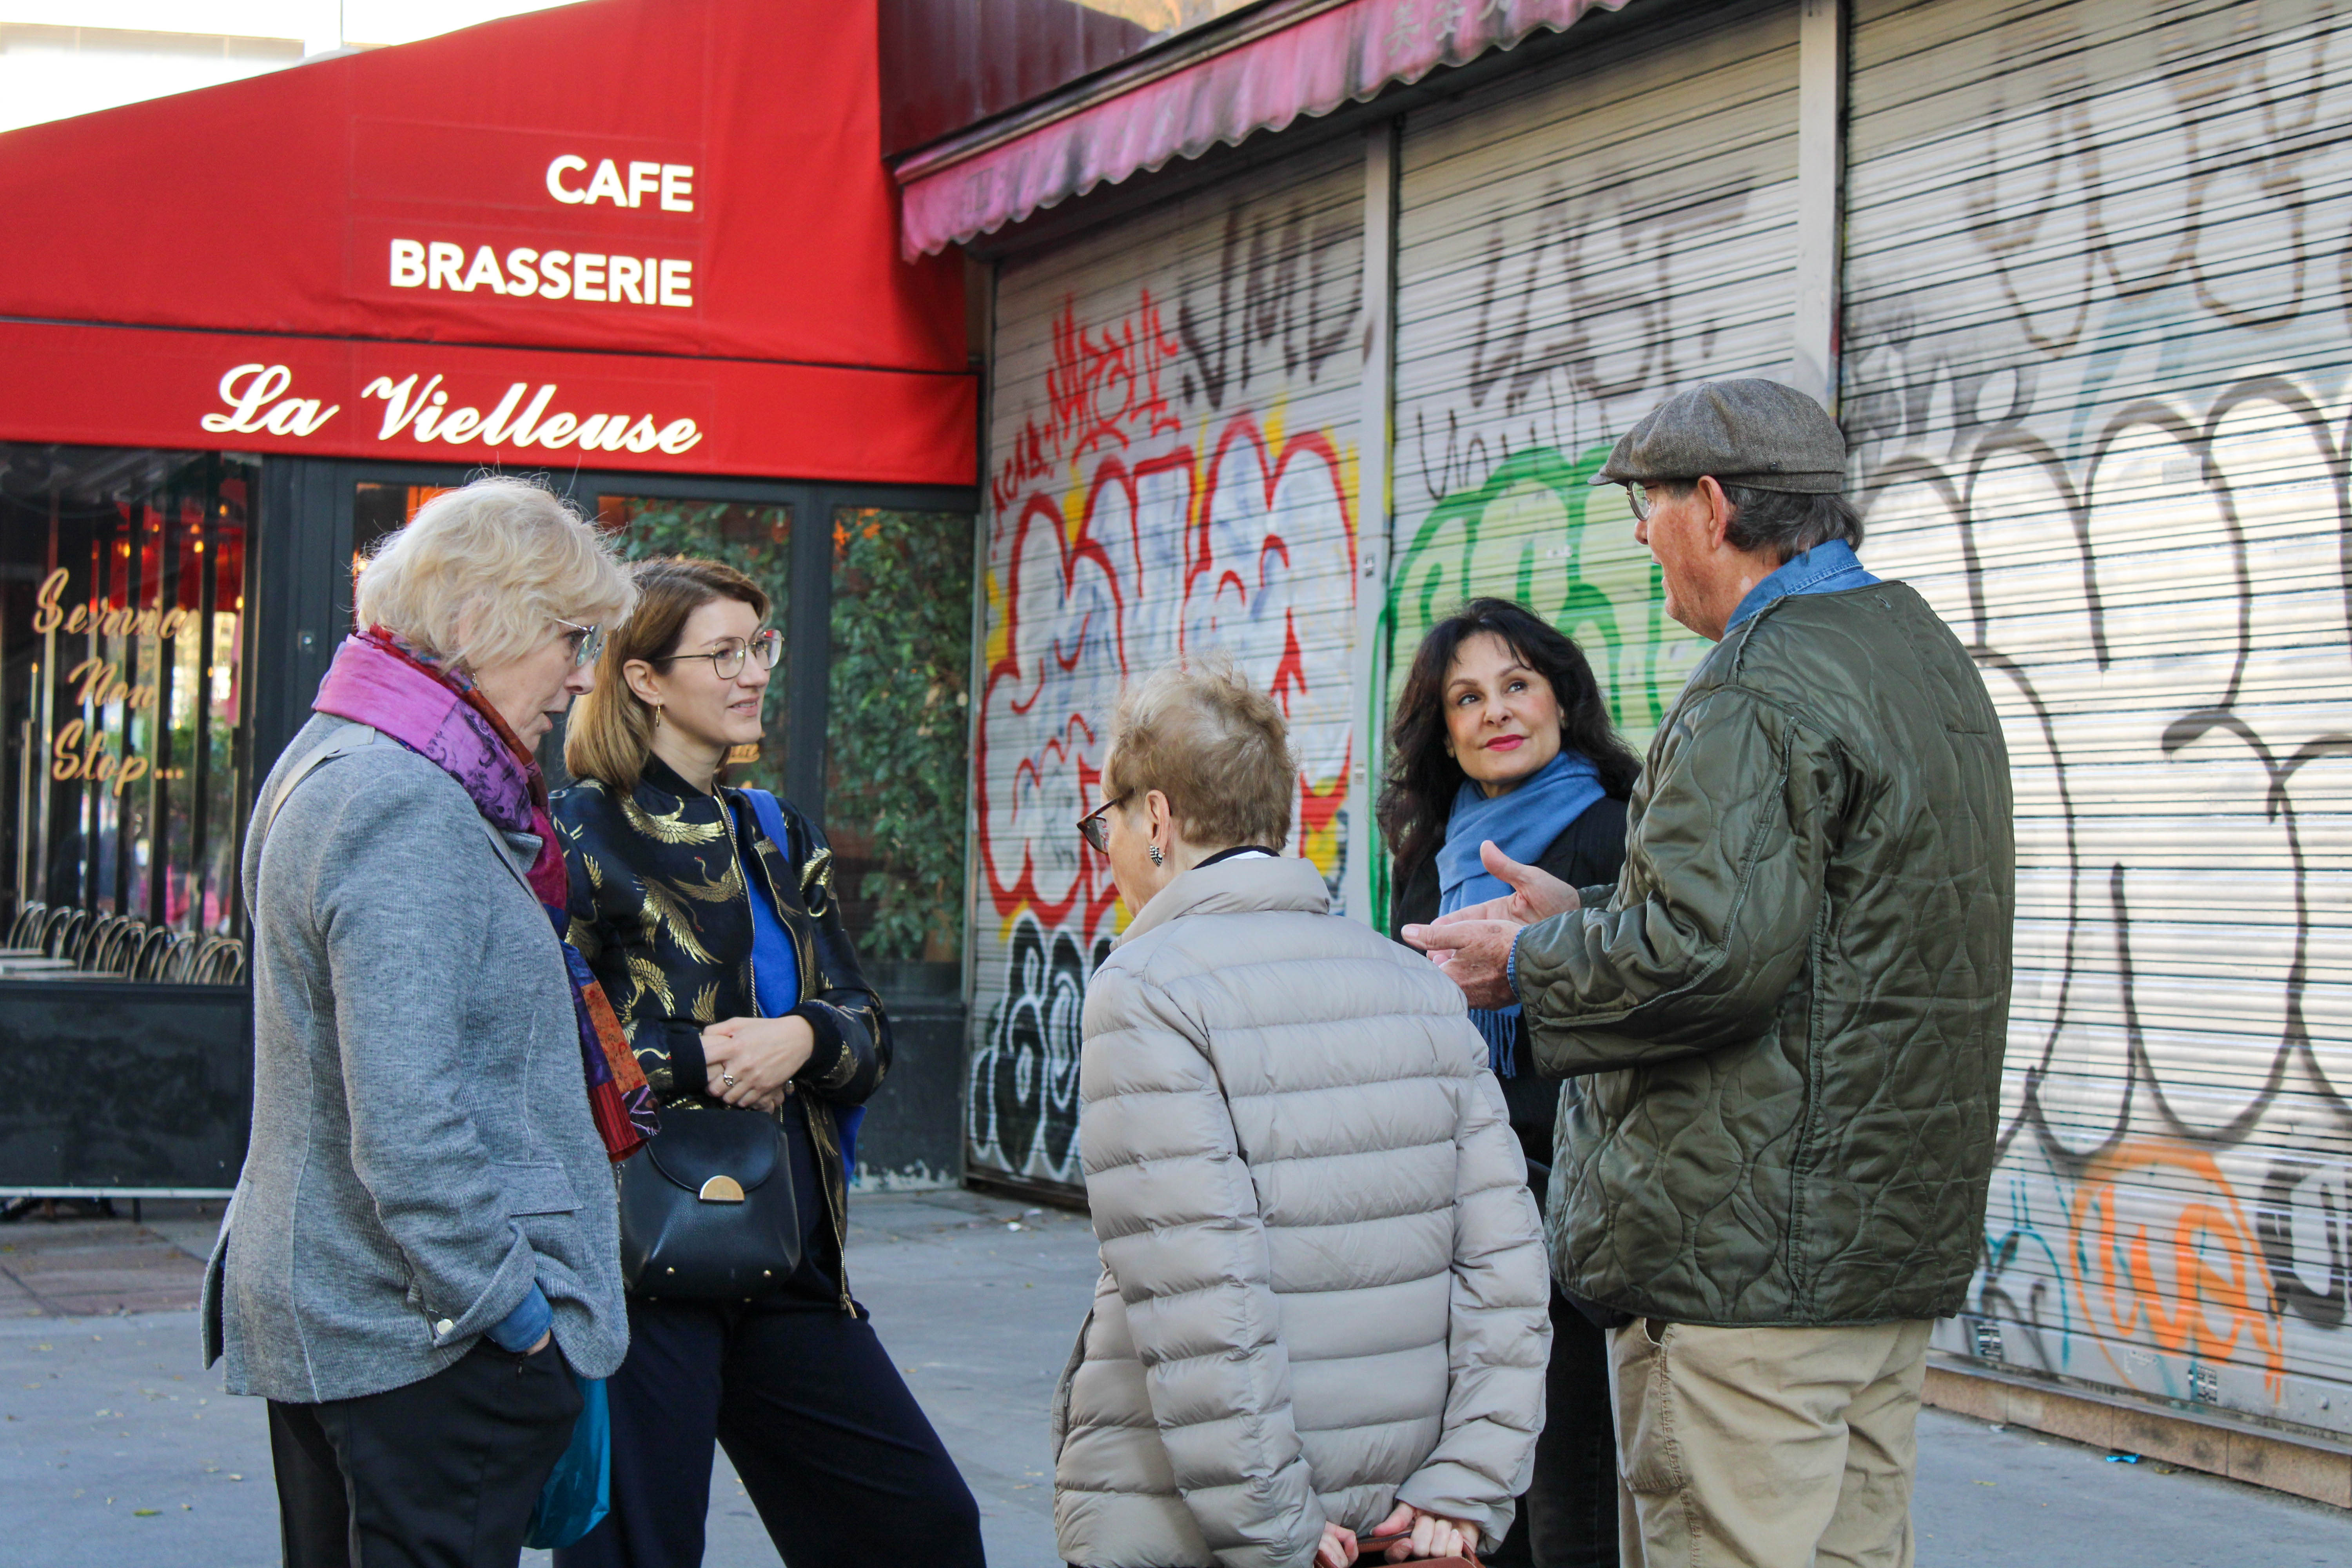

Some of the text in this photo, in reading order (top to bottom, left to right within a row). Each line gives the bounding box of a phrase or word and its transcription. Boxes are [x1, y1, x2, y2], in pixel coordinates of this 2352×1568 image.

[546, 154, 694, 212] CAFE
[390, 239, 693, 307] BRASSERIE
[201, 363, 703, 454] La Vielleuse
[67, 656, 157, 709] Non
